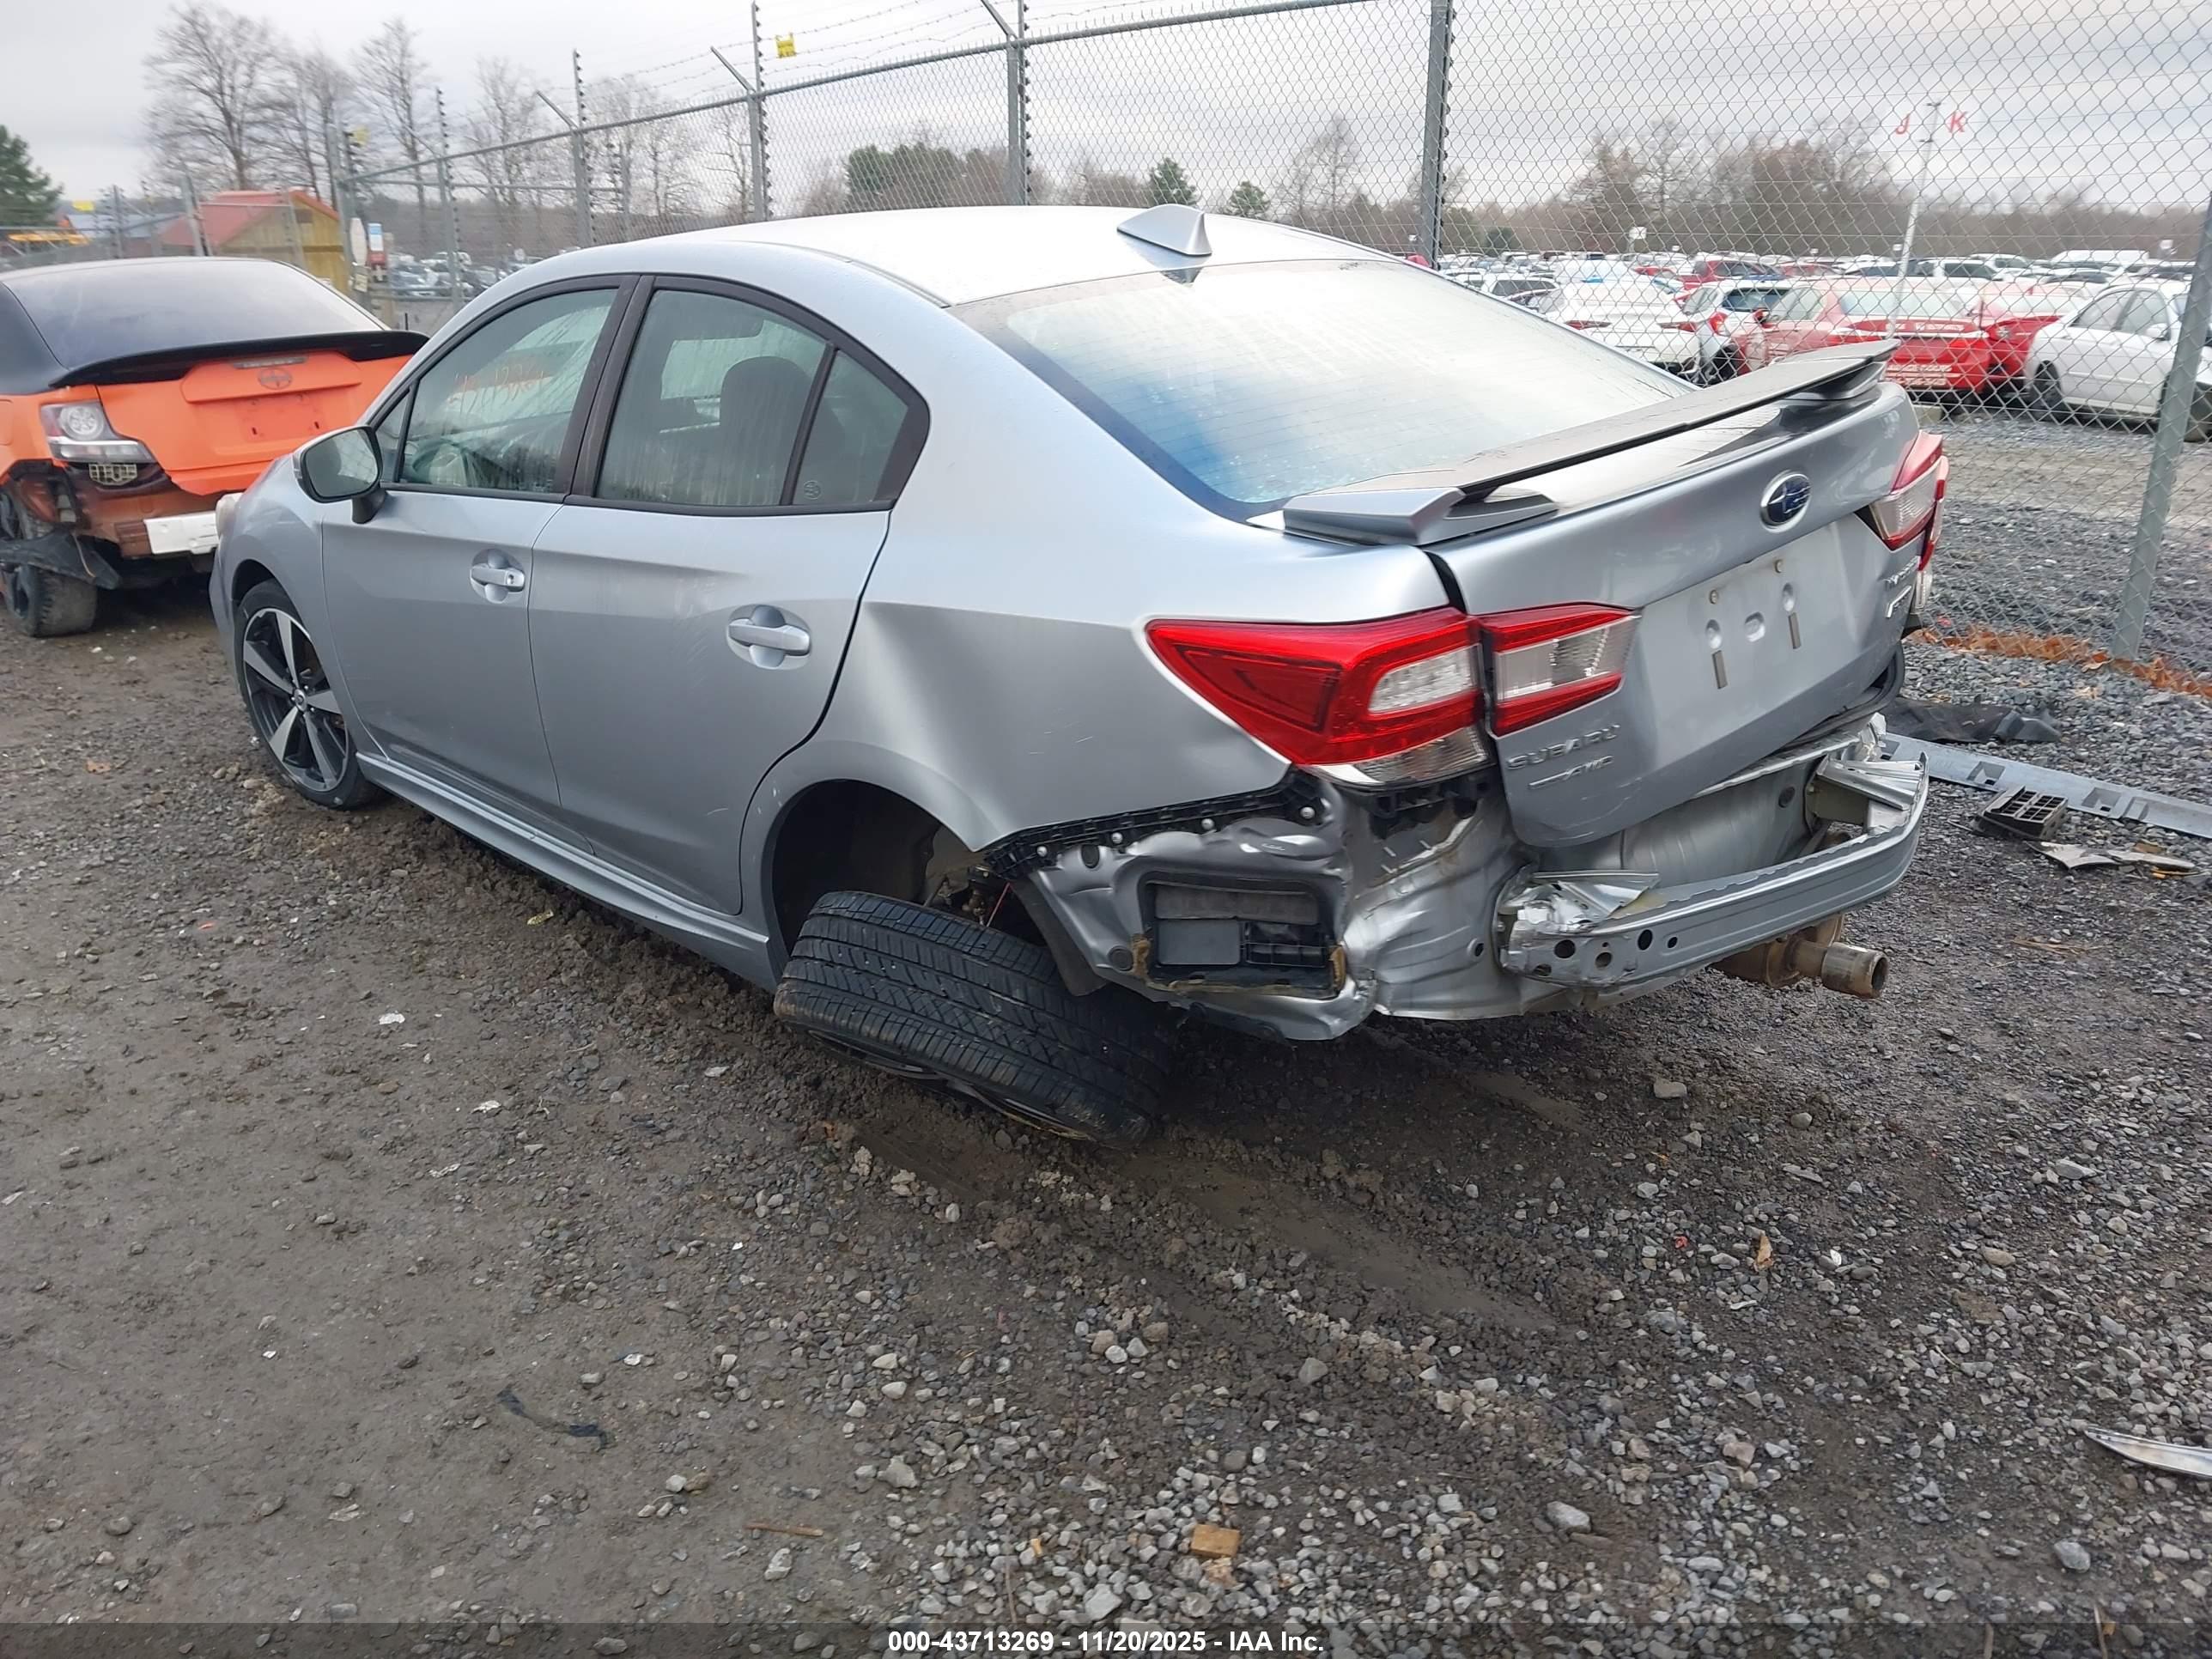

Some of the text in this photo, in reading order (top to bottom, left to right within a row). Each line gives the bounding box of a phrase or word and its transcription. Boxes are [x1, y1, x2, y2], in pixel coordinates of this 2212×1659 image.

[1948, 111, 1968, 133] K
[1506, 724, 1620, 769] SUBARU
[1558, 755, 1614, 781] AWD
